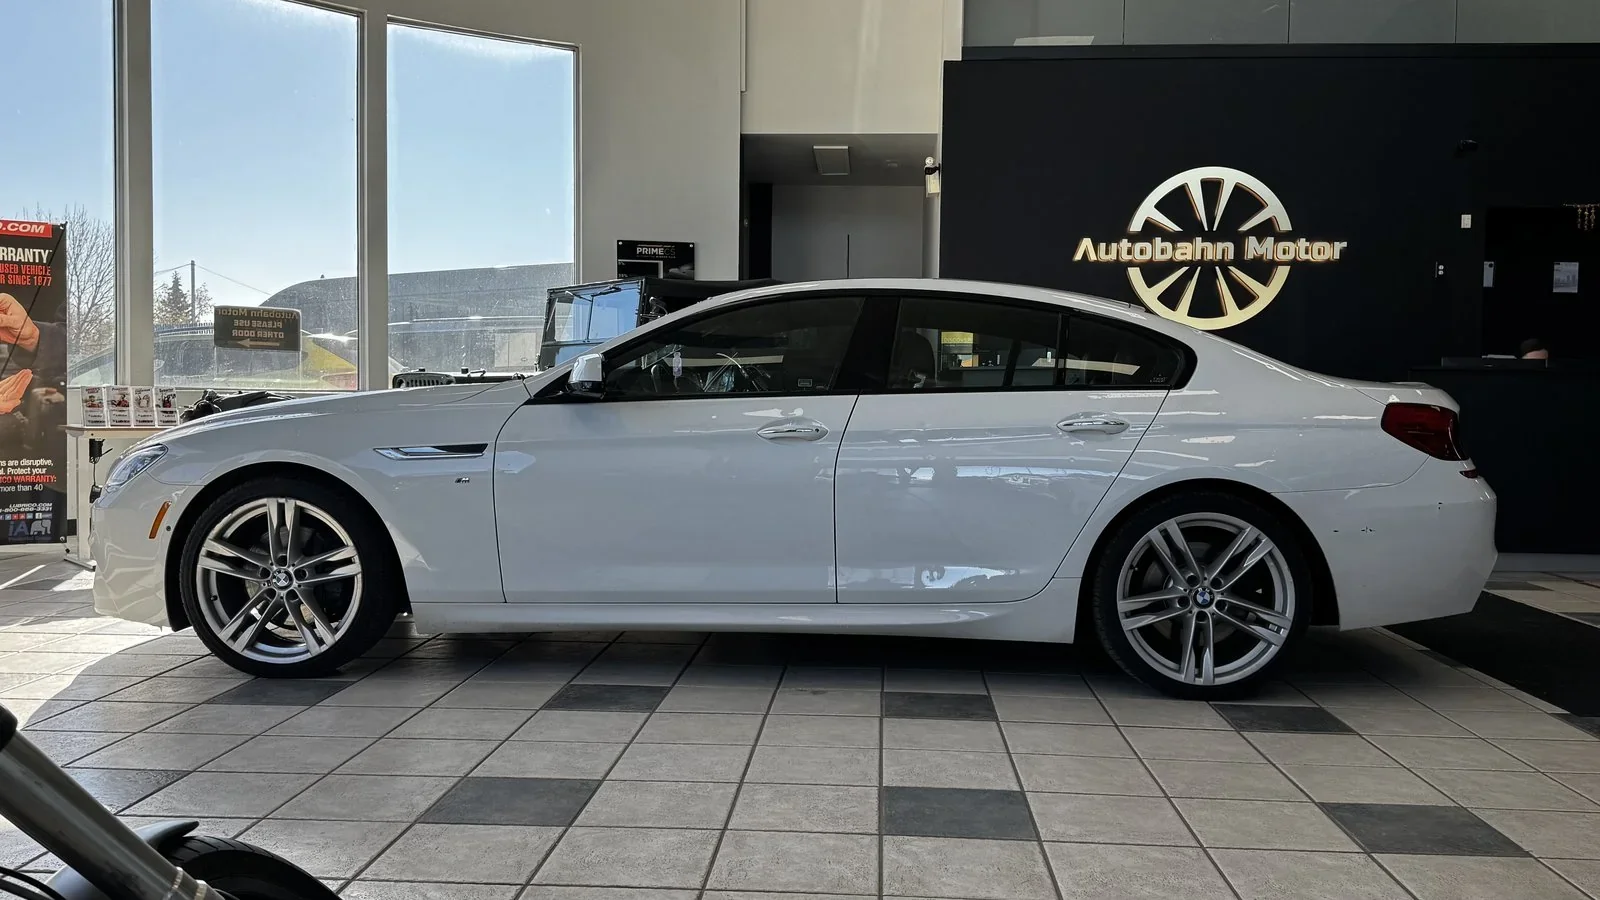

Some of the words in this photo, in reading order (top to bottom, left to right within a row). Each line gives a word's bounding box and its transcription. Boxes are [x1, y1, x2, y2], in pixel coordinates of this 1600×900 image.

[0, 222, 45, 234] .COM
[1072, 237, 1234, 262] Autobahn
[1245, 236, 1347, 261] Motor
[21, 265, 51, 276] VEHICLE
[8, 275, 31, 286] SINCE
[34, 277, 52, 286] 1977
[20, 458, 54, 467] disruptive,
[7, 467, 31, 475] Protect
[32, 468, 48, 476] your
[14, 475, 57, 483] WARRANTY:
[17, 484, 32, 492] than
